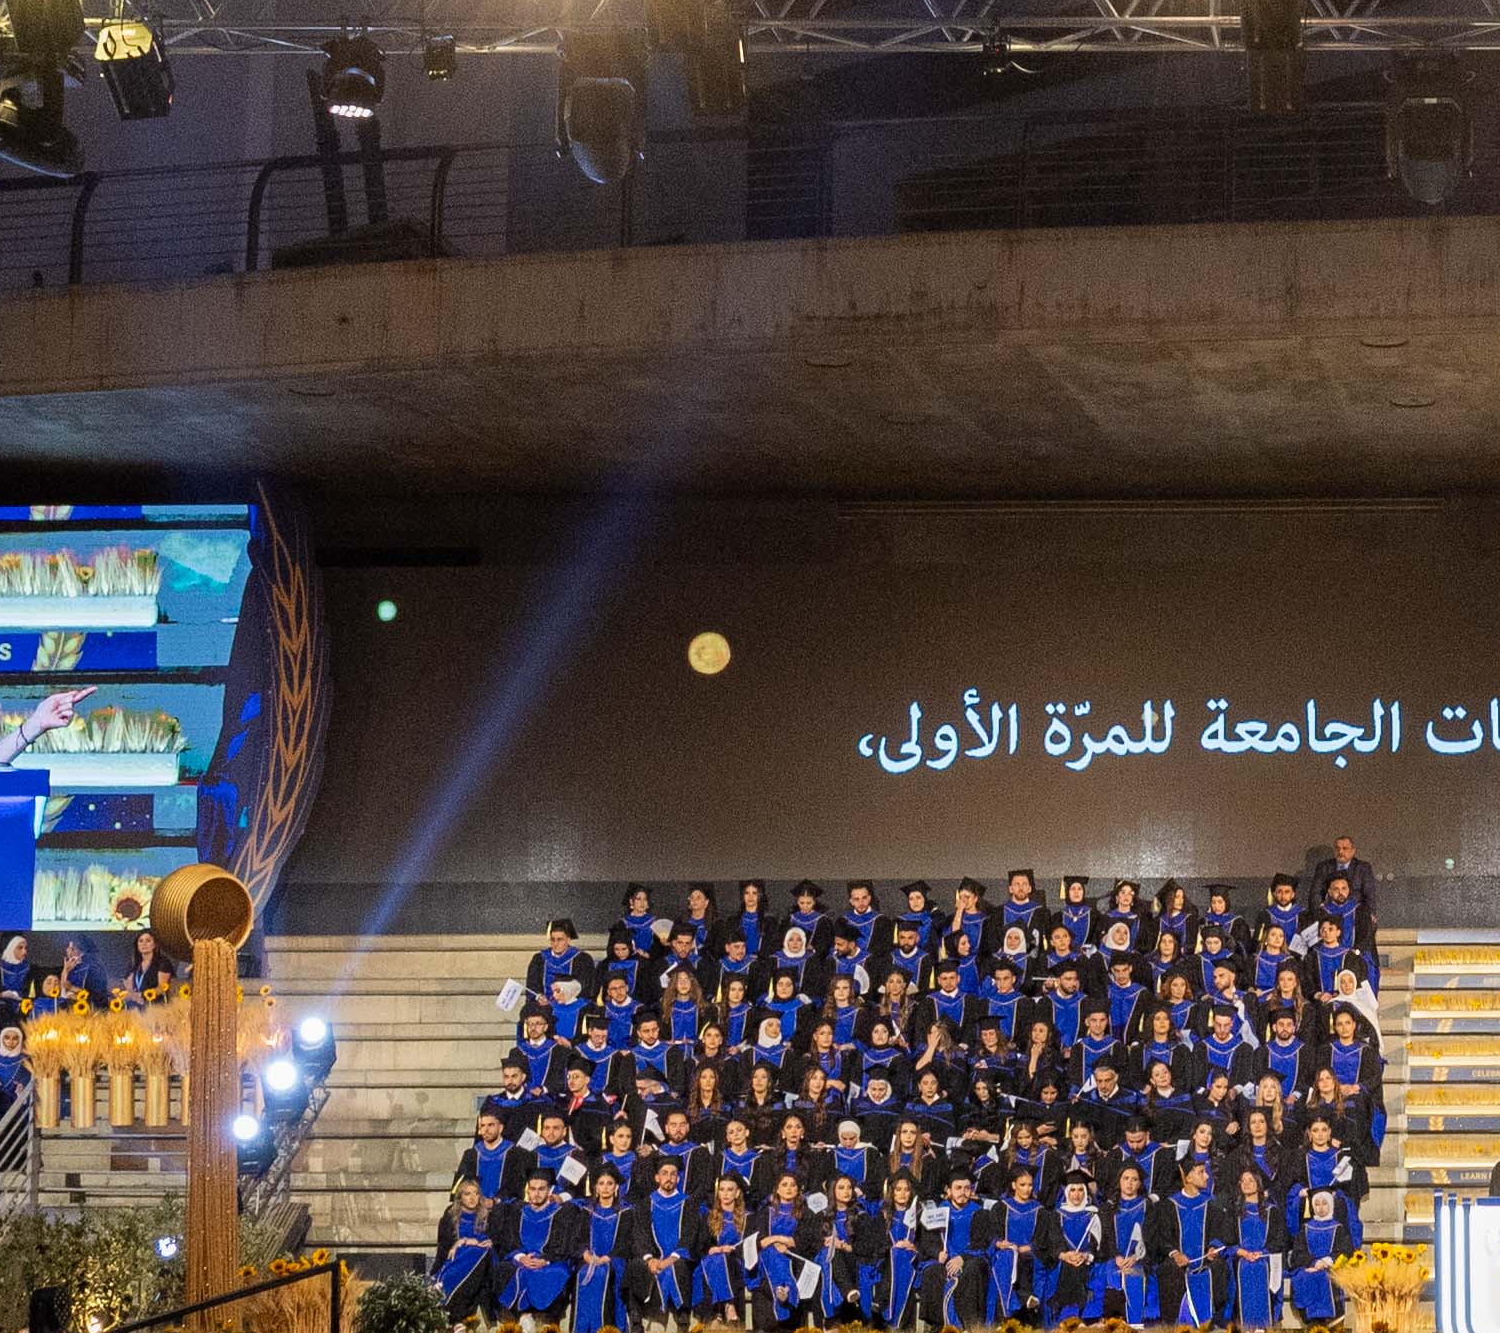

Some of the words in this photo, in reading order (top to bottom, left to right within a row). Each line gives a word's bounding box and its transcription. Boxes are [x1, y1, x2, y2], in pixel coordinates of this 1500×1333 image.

[858, 688, 1018, 773] الأولى،
[1044, 699, 1176, 771] للمرّة
[1200, 698, 1401, 769] الجامعة
[1460, 1170, 1488, 1181] LEARN
